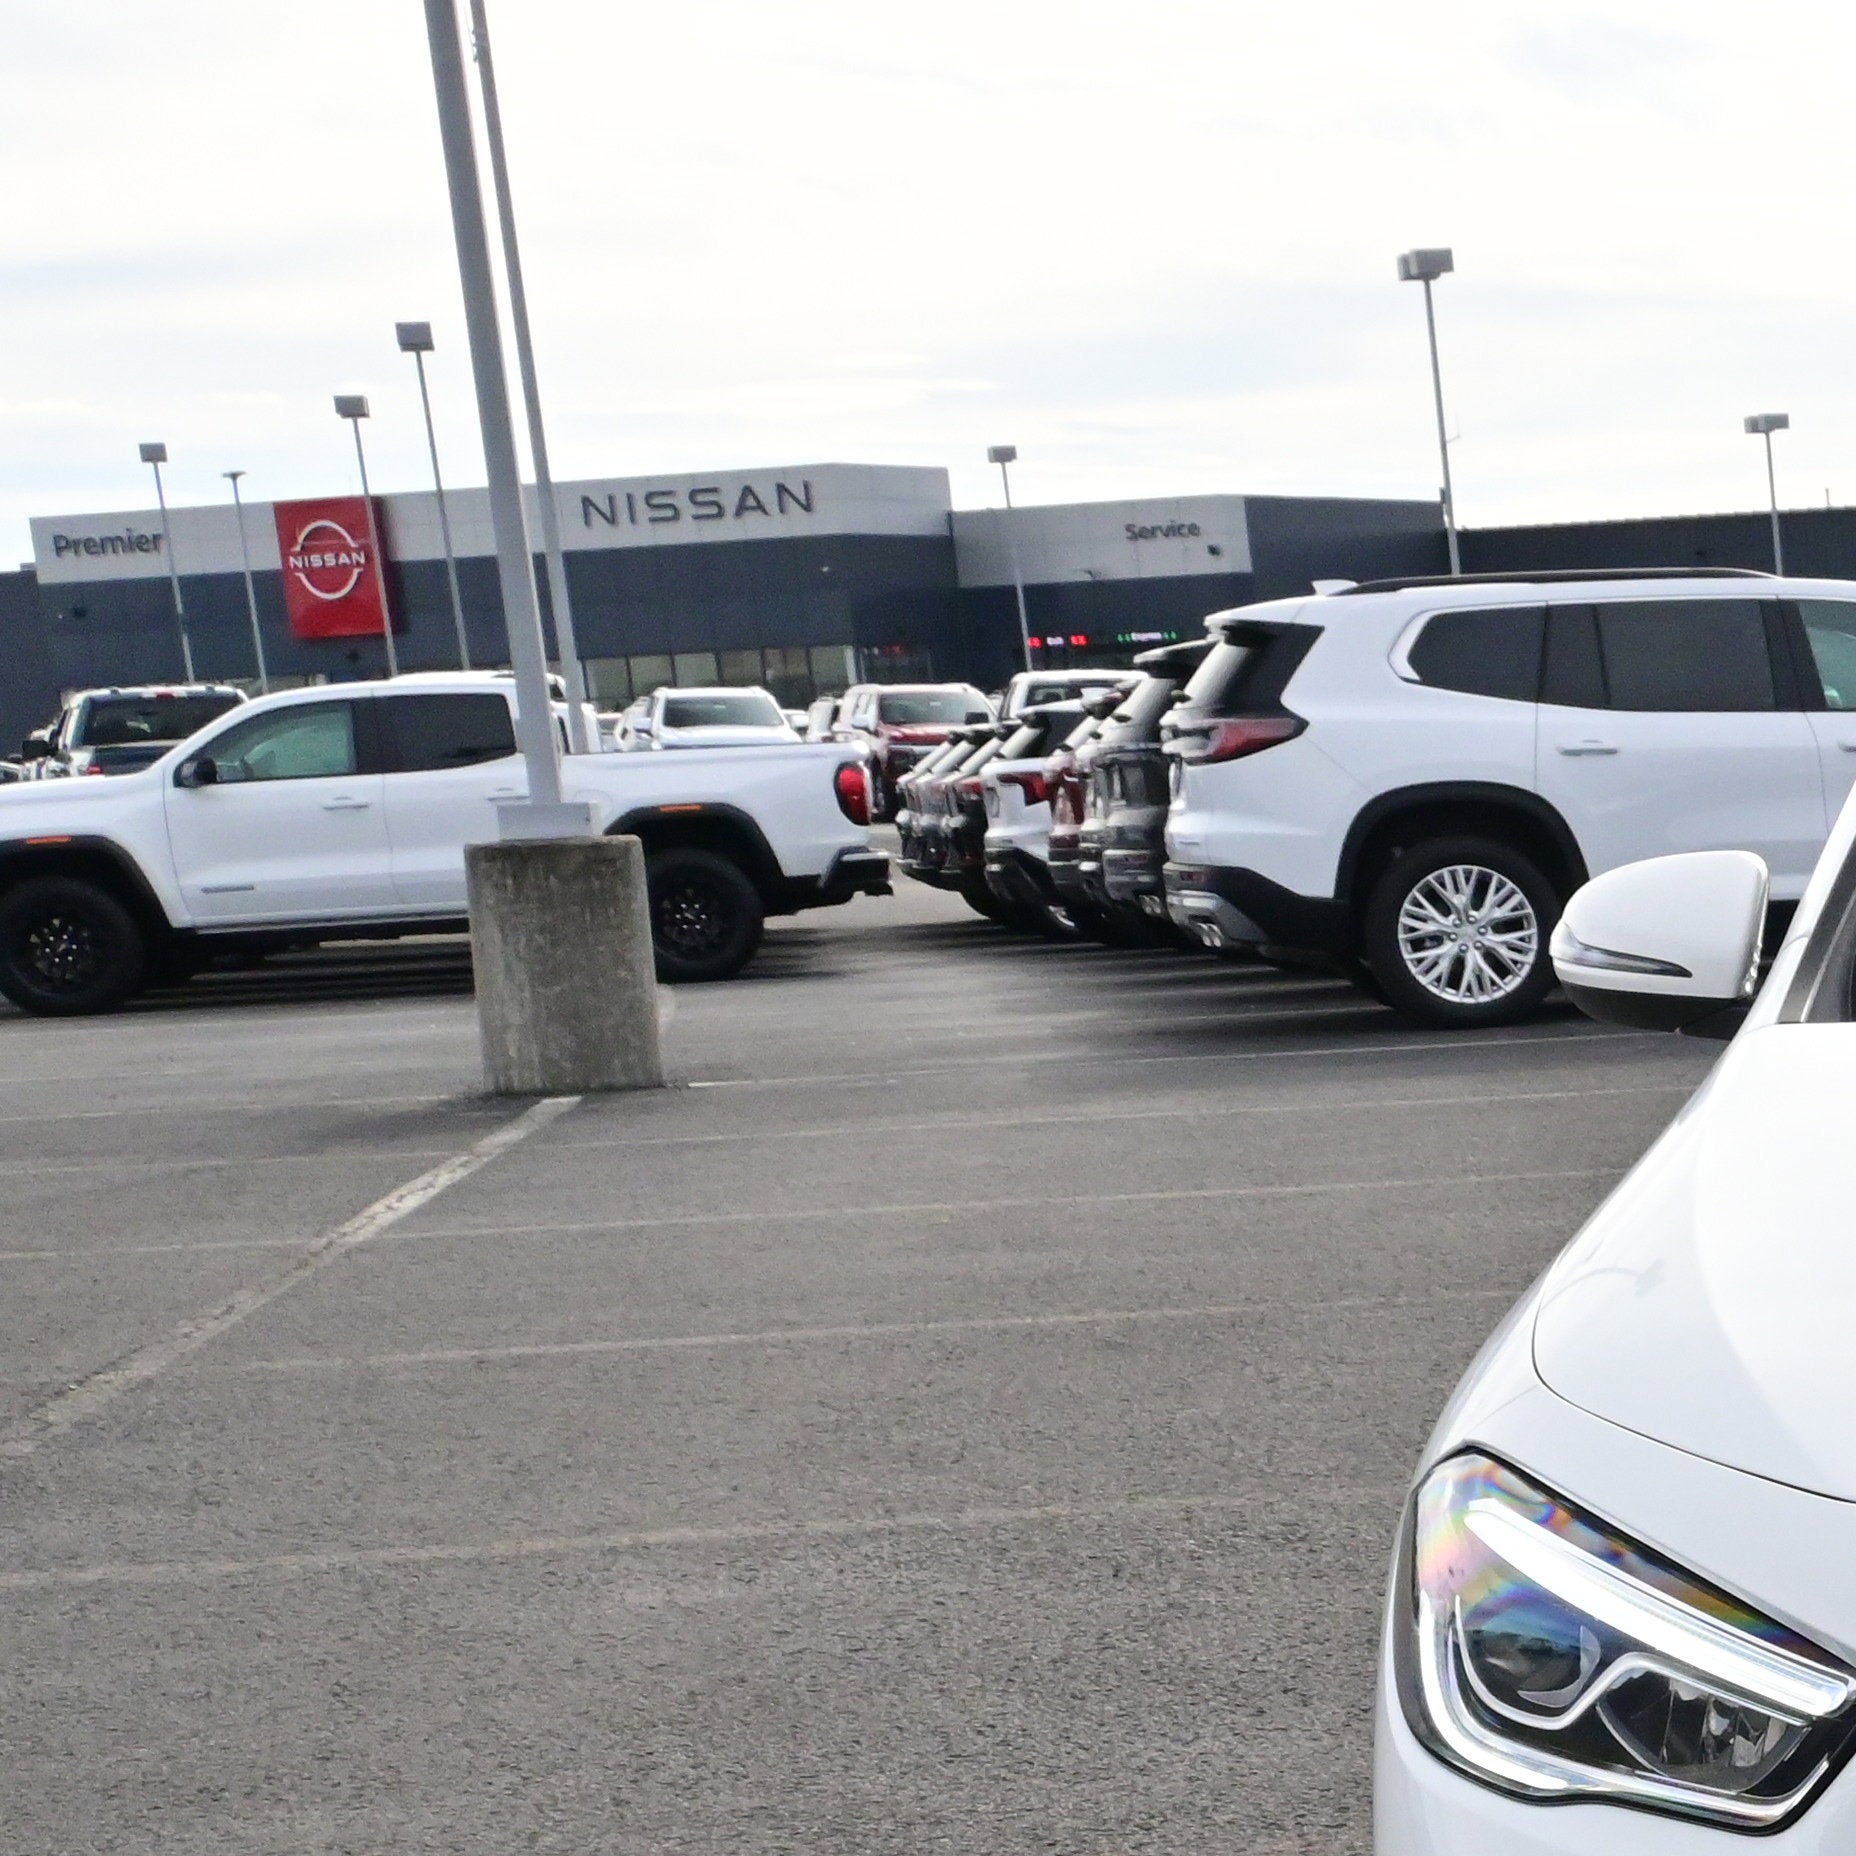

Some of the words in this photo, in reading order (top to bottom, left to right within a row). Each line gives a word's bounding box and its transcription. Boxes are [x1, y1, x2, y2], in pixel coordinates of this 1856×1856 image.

[580, 479, 814, 528] NISSAN
[53, 527, 163, 557] Premier
[1124, 520, 1201, 541] Service
[289, 551, 366, 569] NISSAN
